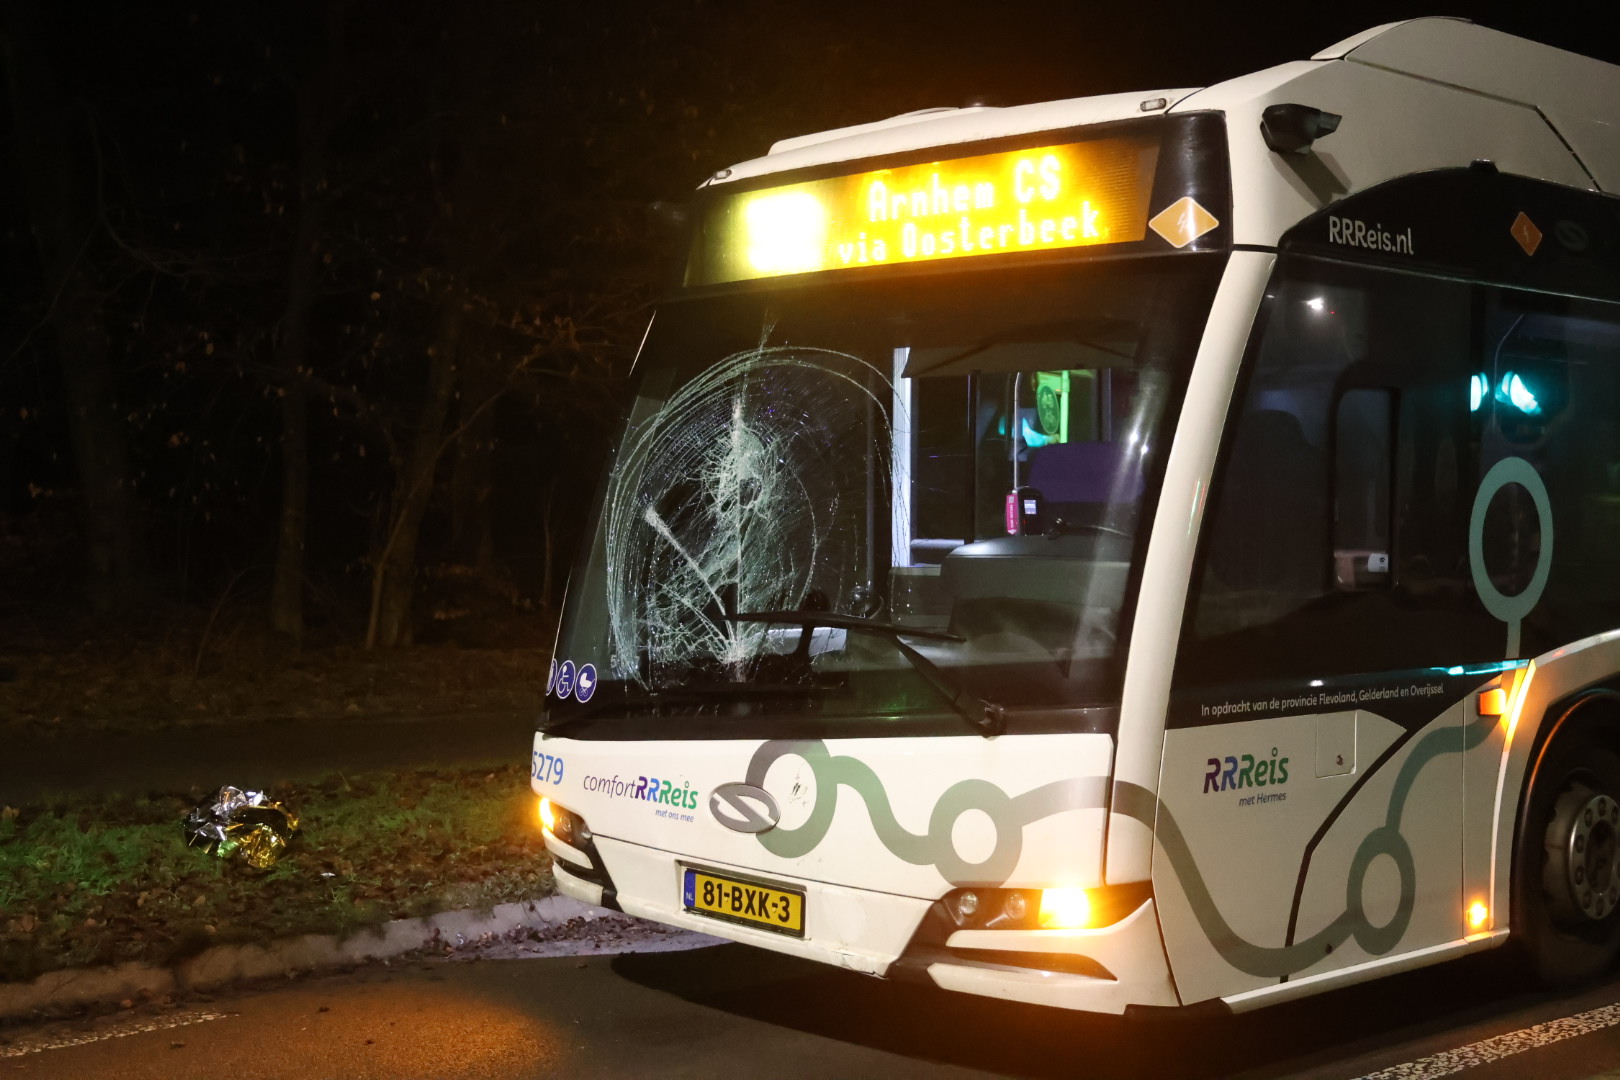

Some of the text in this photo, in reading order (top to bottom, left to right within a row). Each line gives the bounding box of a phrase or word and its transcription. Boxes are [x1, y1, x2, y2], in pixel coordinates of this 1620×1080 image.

[869, 154, 1061, 222] Arnhem CS
[838, 231, 887, 264] via
[902, 200, 1099, 258] Oosterbeek
[1328, 215, 1414, 255] RRReis.nl
[1201, 683, 1444, 717] In opdracht van de provincie Flevoland, Gelderland en Overijssel
[1203, 746, 1289, 794] RRReis
[583, 775, 699, 810] comfortRRReis
[1238, 792, 1287, 807] met Hermes
[654, 808, 695, 823] met ons mee
[686, 880, 790, 923] NL 81-BXK-3
